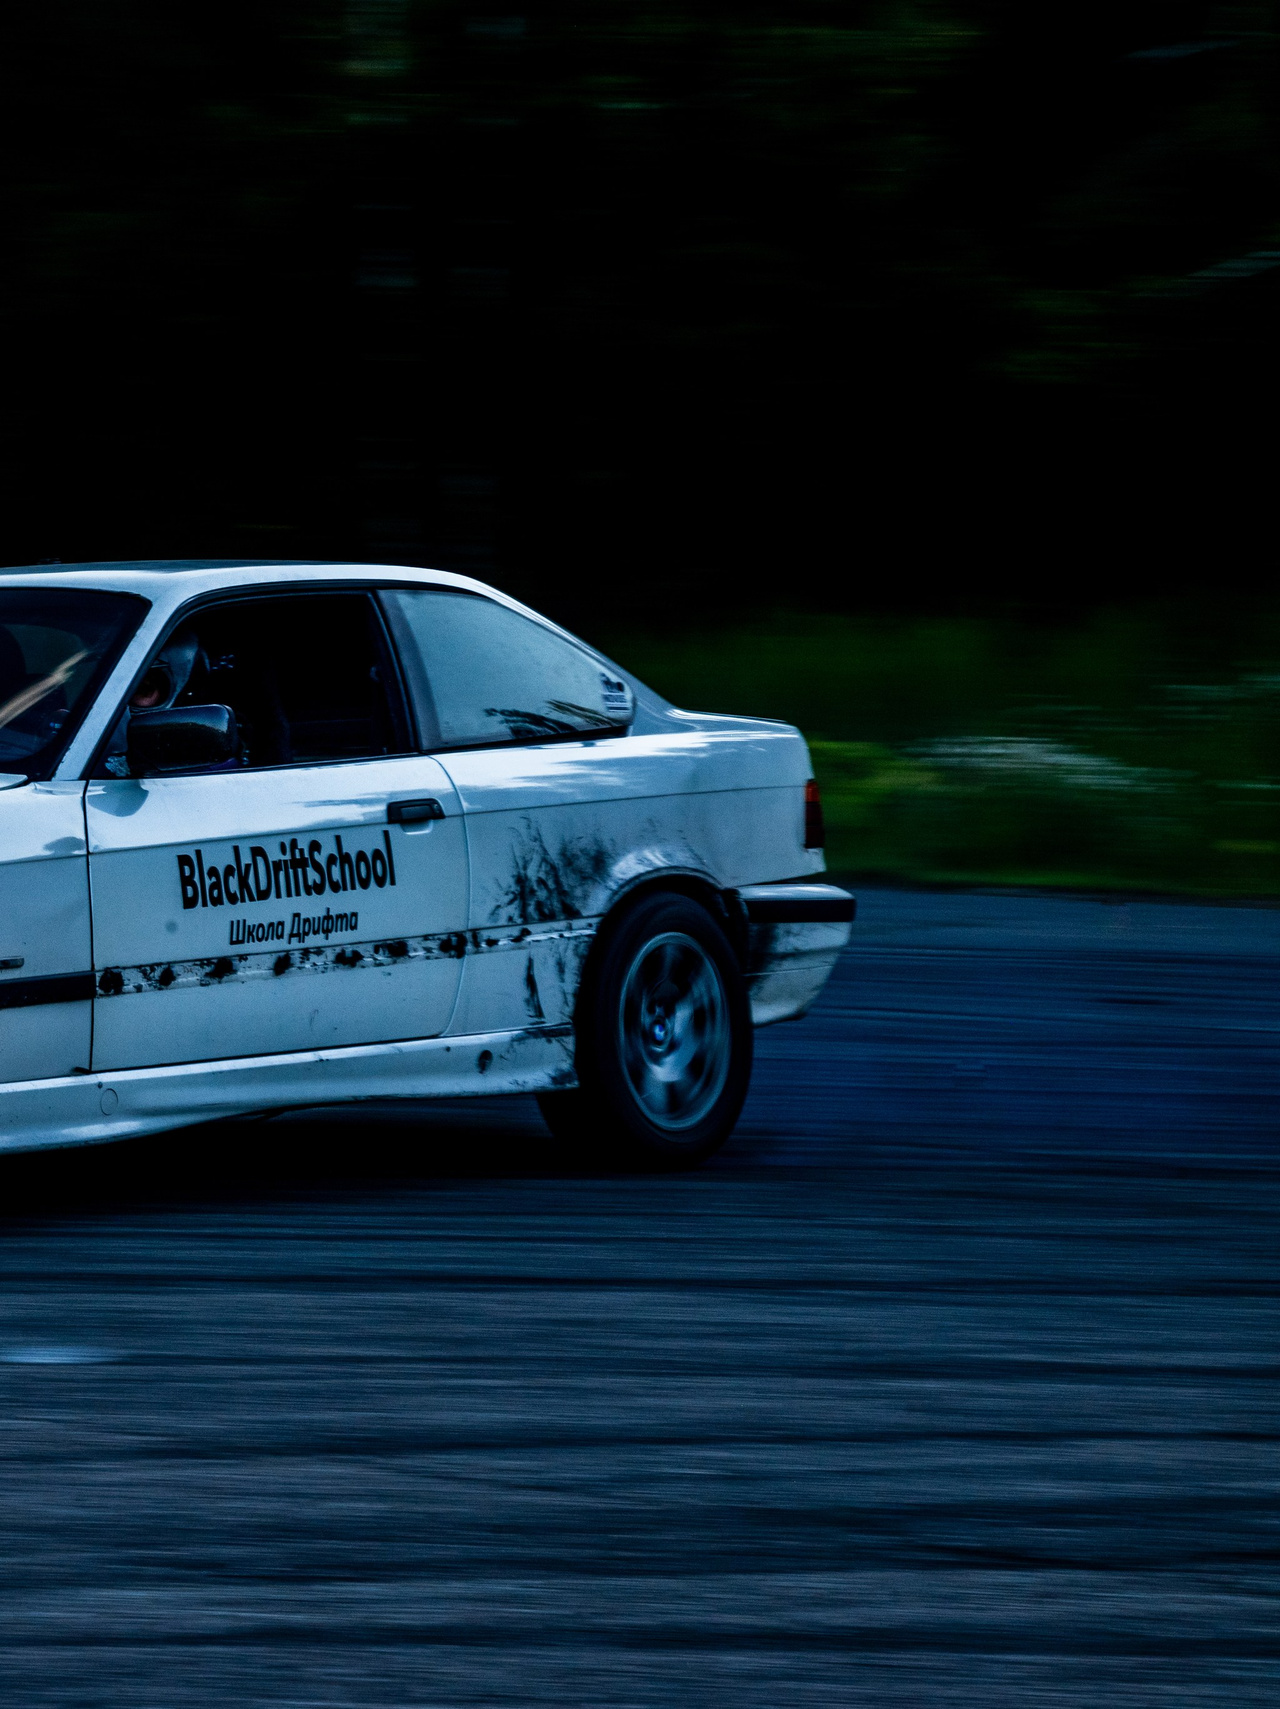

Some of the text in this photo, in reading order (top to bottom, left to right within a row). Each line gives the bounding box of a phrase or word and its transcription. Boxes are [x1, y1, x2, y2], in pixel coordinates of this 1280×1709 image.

[177, 830, 396, 910] BlackDriftSchool
[229, 908, 359, 945] Школа Дрифта
